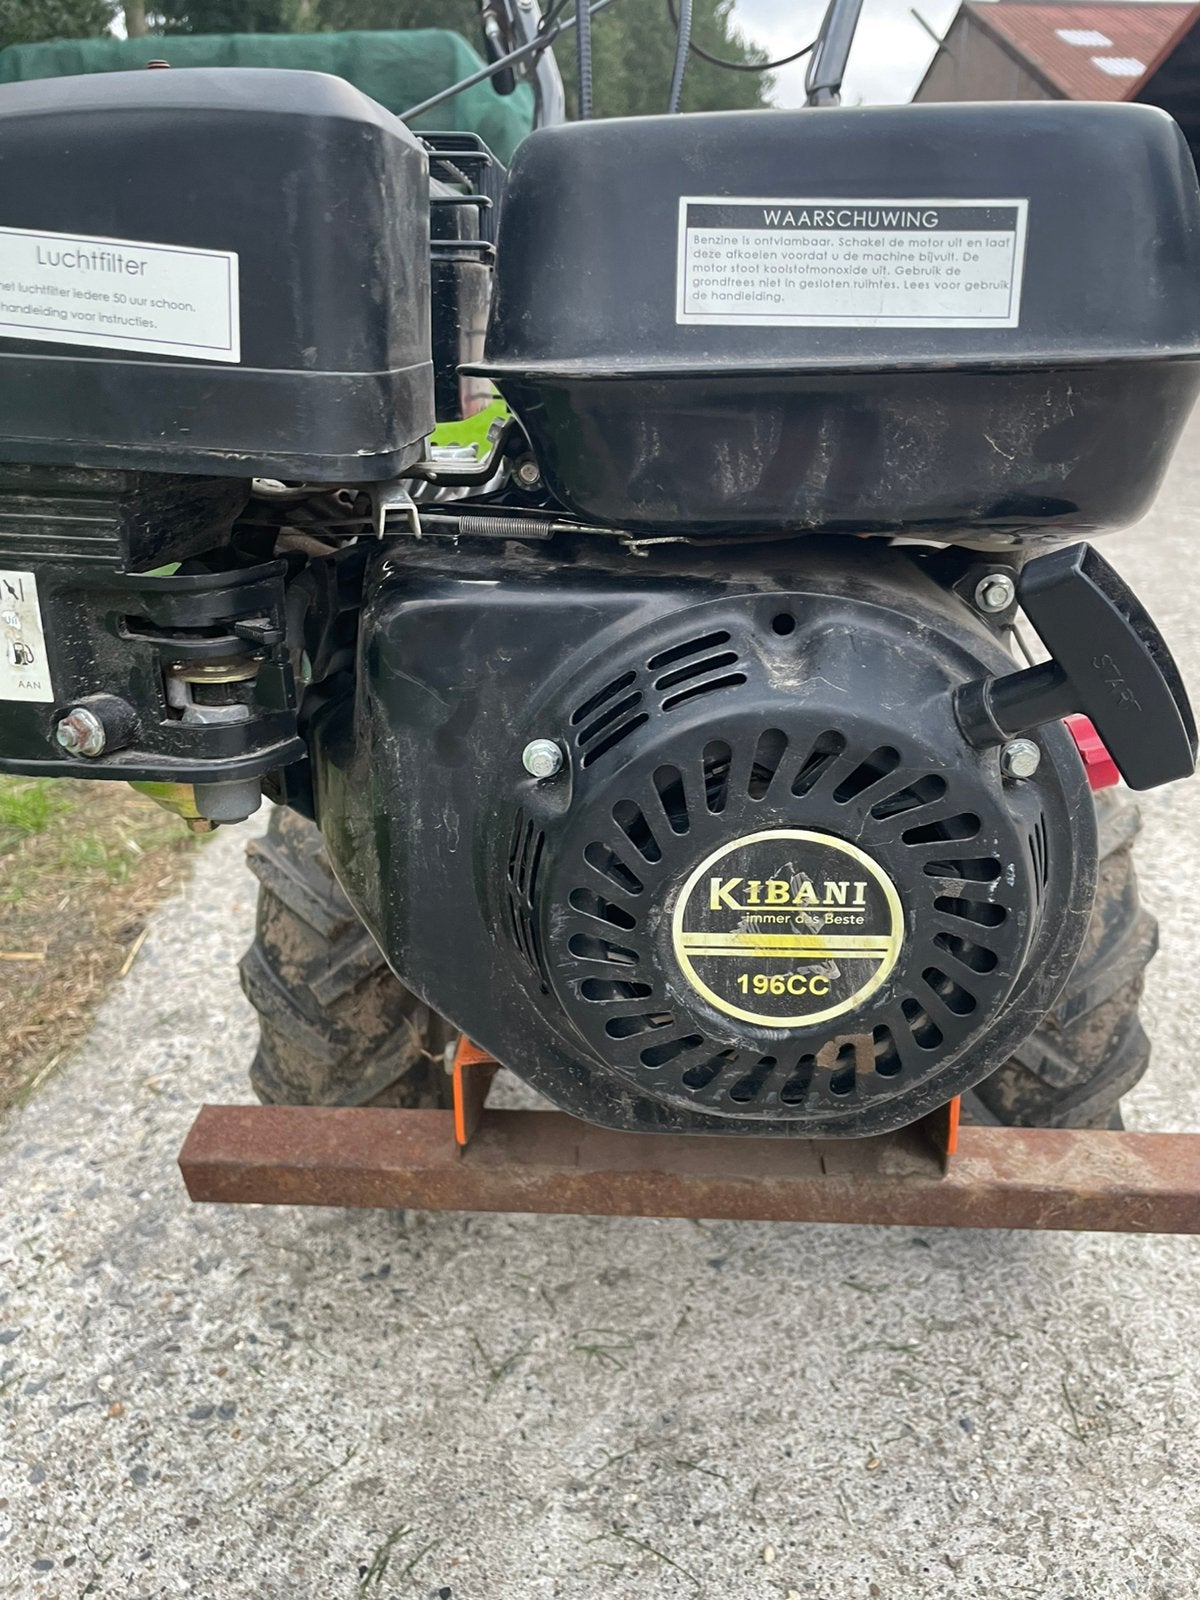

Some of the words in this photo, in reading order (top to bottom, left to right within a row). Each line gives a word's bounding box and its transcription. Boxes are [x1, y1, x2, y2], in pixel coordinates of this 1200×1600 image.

[763, 209, 939, 228] WAARSCHUWING
[693, 235, 739, 245] Benzine
[742, 235, 750, 246] is
[754, 236, 834, 247] ontvlambaar.
[838, 237, 885, 247] Schakel
[889, 237, 904, 248] de
[908, 238, 944, 248] motor
[948, 238, 962, 248] uit
[967, 239, 982, 248] en
[986, 238, 1010, 248] laat
[36, 245, 148, 276] Luchtfilter
[693, 249, 722, 259] deze
[725, 249, 777, 260] afkoelen
[781, 250, 828, 261] voordat
[831, 253, 839, 261] u
[843, 251, 859, 261] de
[862, 251, 915, 261] machine
[919, 252, 958, 264] bijvult.
[962, 252, 979, 262] De
[692, 263, 727, 273] motor
[731, 264, 760, 273] stoot
[764, 264, 868, 275] koolstofmonoxide
[872, 265, 891, 276] uit.
[895, 266, 942, 276] Gebruik
[945, 266, 961, 276] de
[692, 276, 755, 288] grondfrees
[759, 277, 781, 287] niet
[785, 278, 796, 288] in
[799, 279, 850, 290] gesloten
[853, 280, 900, 290] ruimtes.
[903, 280, 930, 290] Lees
[934, 281, 961, 290] voor
[964, 280, 1010, 292] gebruik
[18, 281, 70, 298] luchtfilter
[72, 287, 110, 302] iedere
[113, 292, 127, 304] 50
[129, 295, 147, 306] uur
[151, 296, 196, 312] schoon.
[692, 290, 707, 300] de
[711, 291, 785, 303] handleiding.
[70, 310, 96, 322] voor
[99, 311, 158, 329] instructies.
[18, 680, 42, 690] AAN
[709, 877, 868, 911] KIBANI
[745, 912, 790, 924] immer
[824, 913, 864, 925] Beste
[737, 973, 830, 996] 196CC
